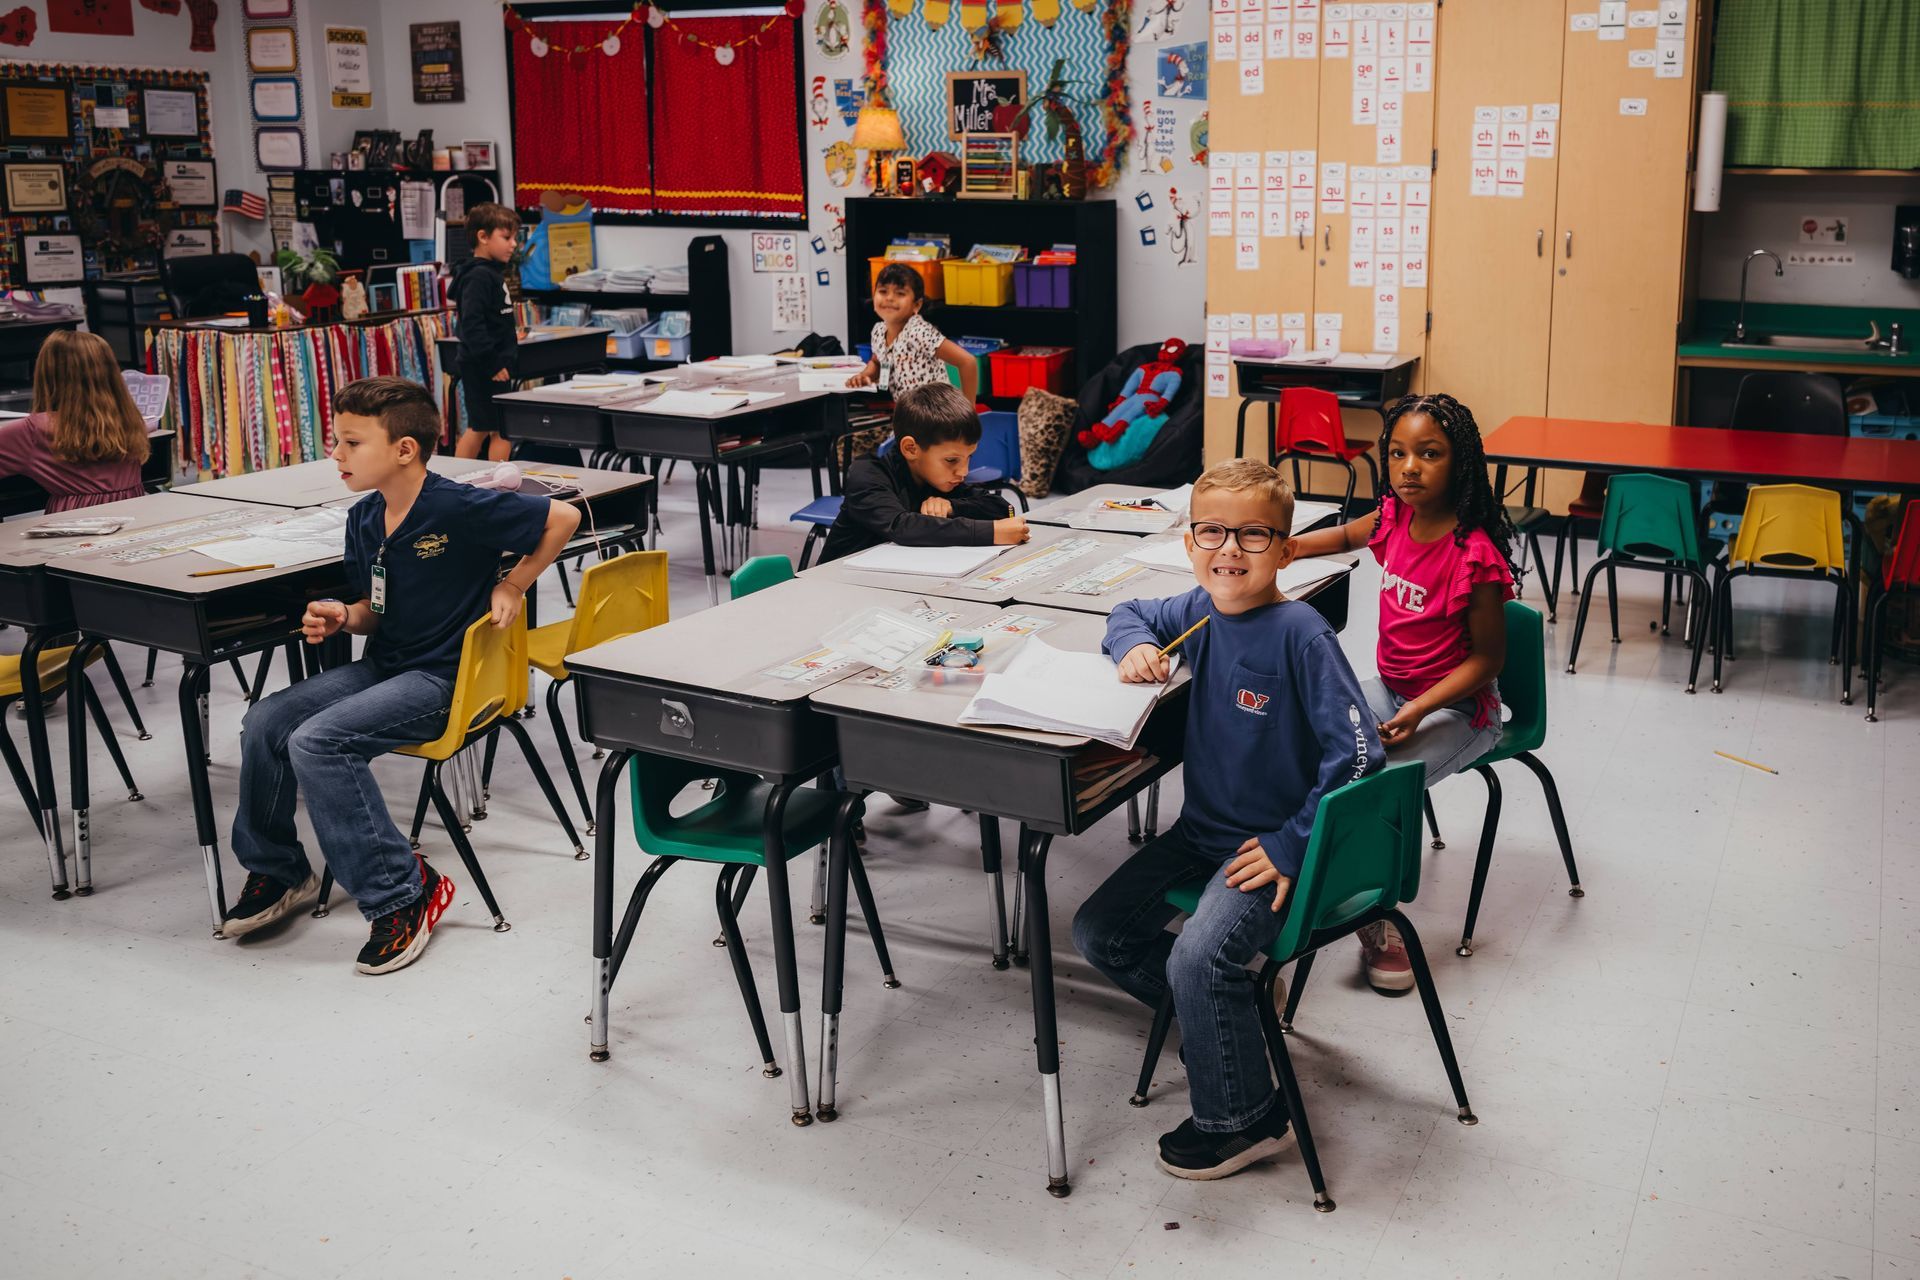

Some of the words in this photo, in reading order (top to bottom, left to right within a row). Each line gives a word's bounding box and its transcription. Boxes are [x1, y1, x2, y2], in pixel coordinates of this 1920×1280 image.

[328, 31, 366, 43] SCHOOL
[1217, 32, 1233, 44] bb
[1244, 31, 1259, 43] dd
[1273, 28, 1283, 40] ff
[1297, 31, 1313, 45] gg
[1332, 29, 1341, 40] h
[1388, 28, 1396, 39] k
[1666, 50, 1675, 59] u
[1244, 65, 1260, 77] ed
[1357, 64, 1373, 77] ge
[972, 79, 997, 107] Mrs
[340, 95, 364, 107] ZONE
[1361, 97, 1369, 109] g
[1382, 102, 1398, 111] cc
[954, 104, 994, 132] Miller
[1157, 117, 1176, 128] you
[1382, 134, 1396, 146] ck
[1477, 128, 1493, 142] ch
[1508, 129, 1520, 142] th
[1535, 128, 1549, 140] sh
[1475, 166, 1494, 178] tch
[1506, 166, 1518, 178] th
[1216, 176, 1226, 184] m
[1268, 175, 1283, 187] ng
[1299, 173, 1307, 184] p
[1326, 186, 1341, 198] qu
[1211, 210, 1231, 219] mm
[1241, 210, 1255, 219] nn
[1294, 210, 1310, 221] pp
[1357, 226, 1368, 235] rr
[1383, 226, 1394, 235] ss
[1241, 242, 1254, 253] kn
[1354, 260, 1369, 270] wr
[1381, 261, 1394, 271] se
[1406, 259, 1423, 271] ed
[1379, 293, 1394, 302] ce
[1212, 373, 1225, 382] ve
